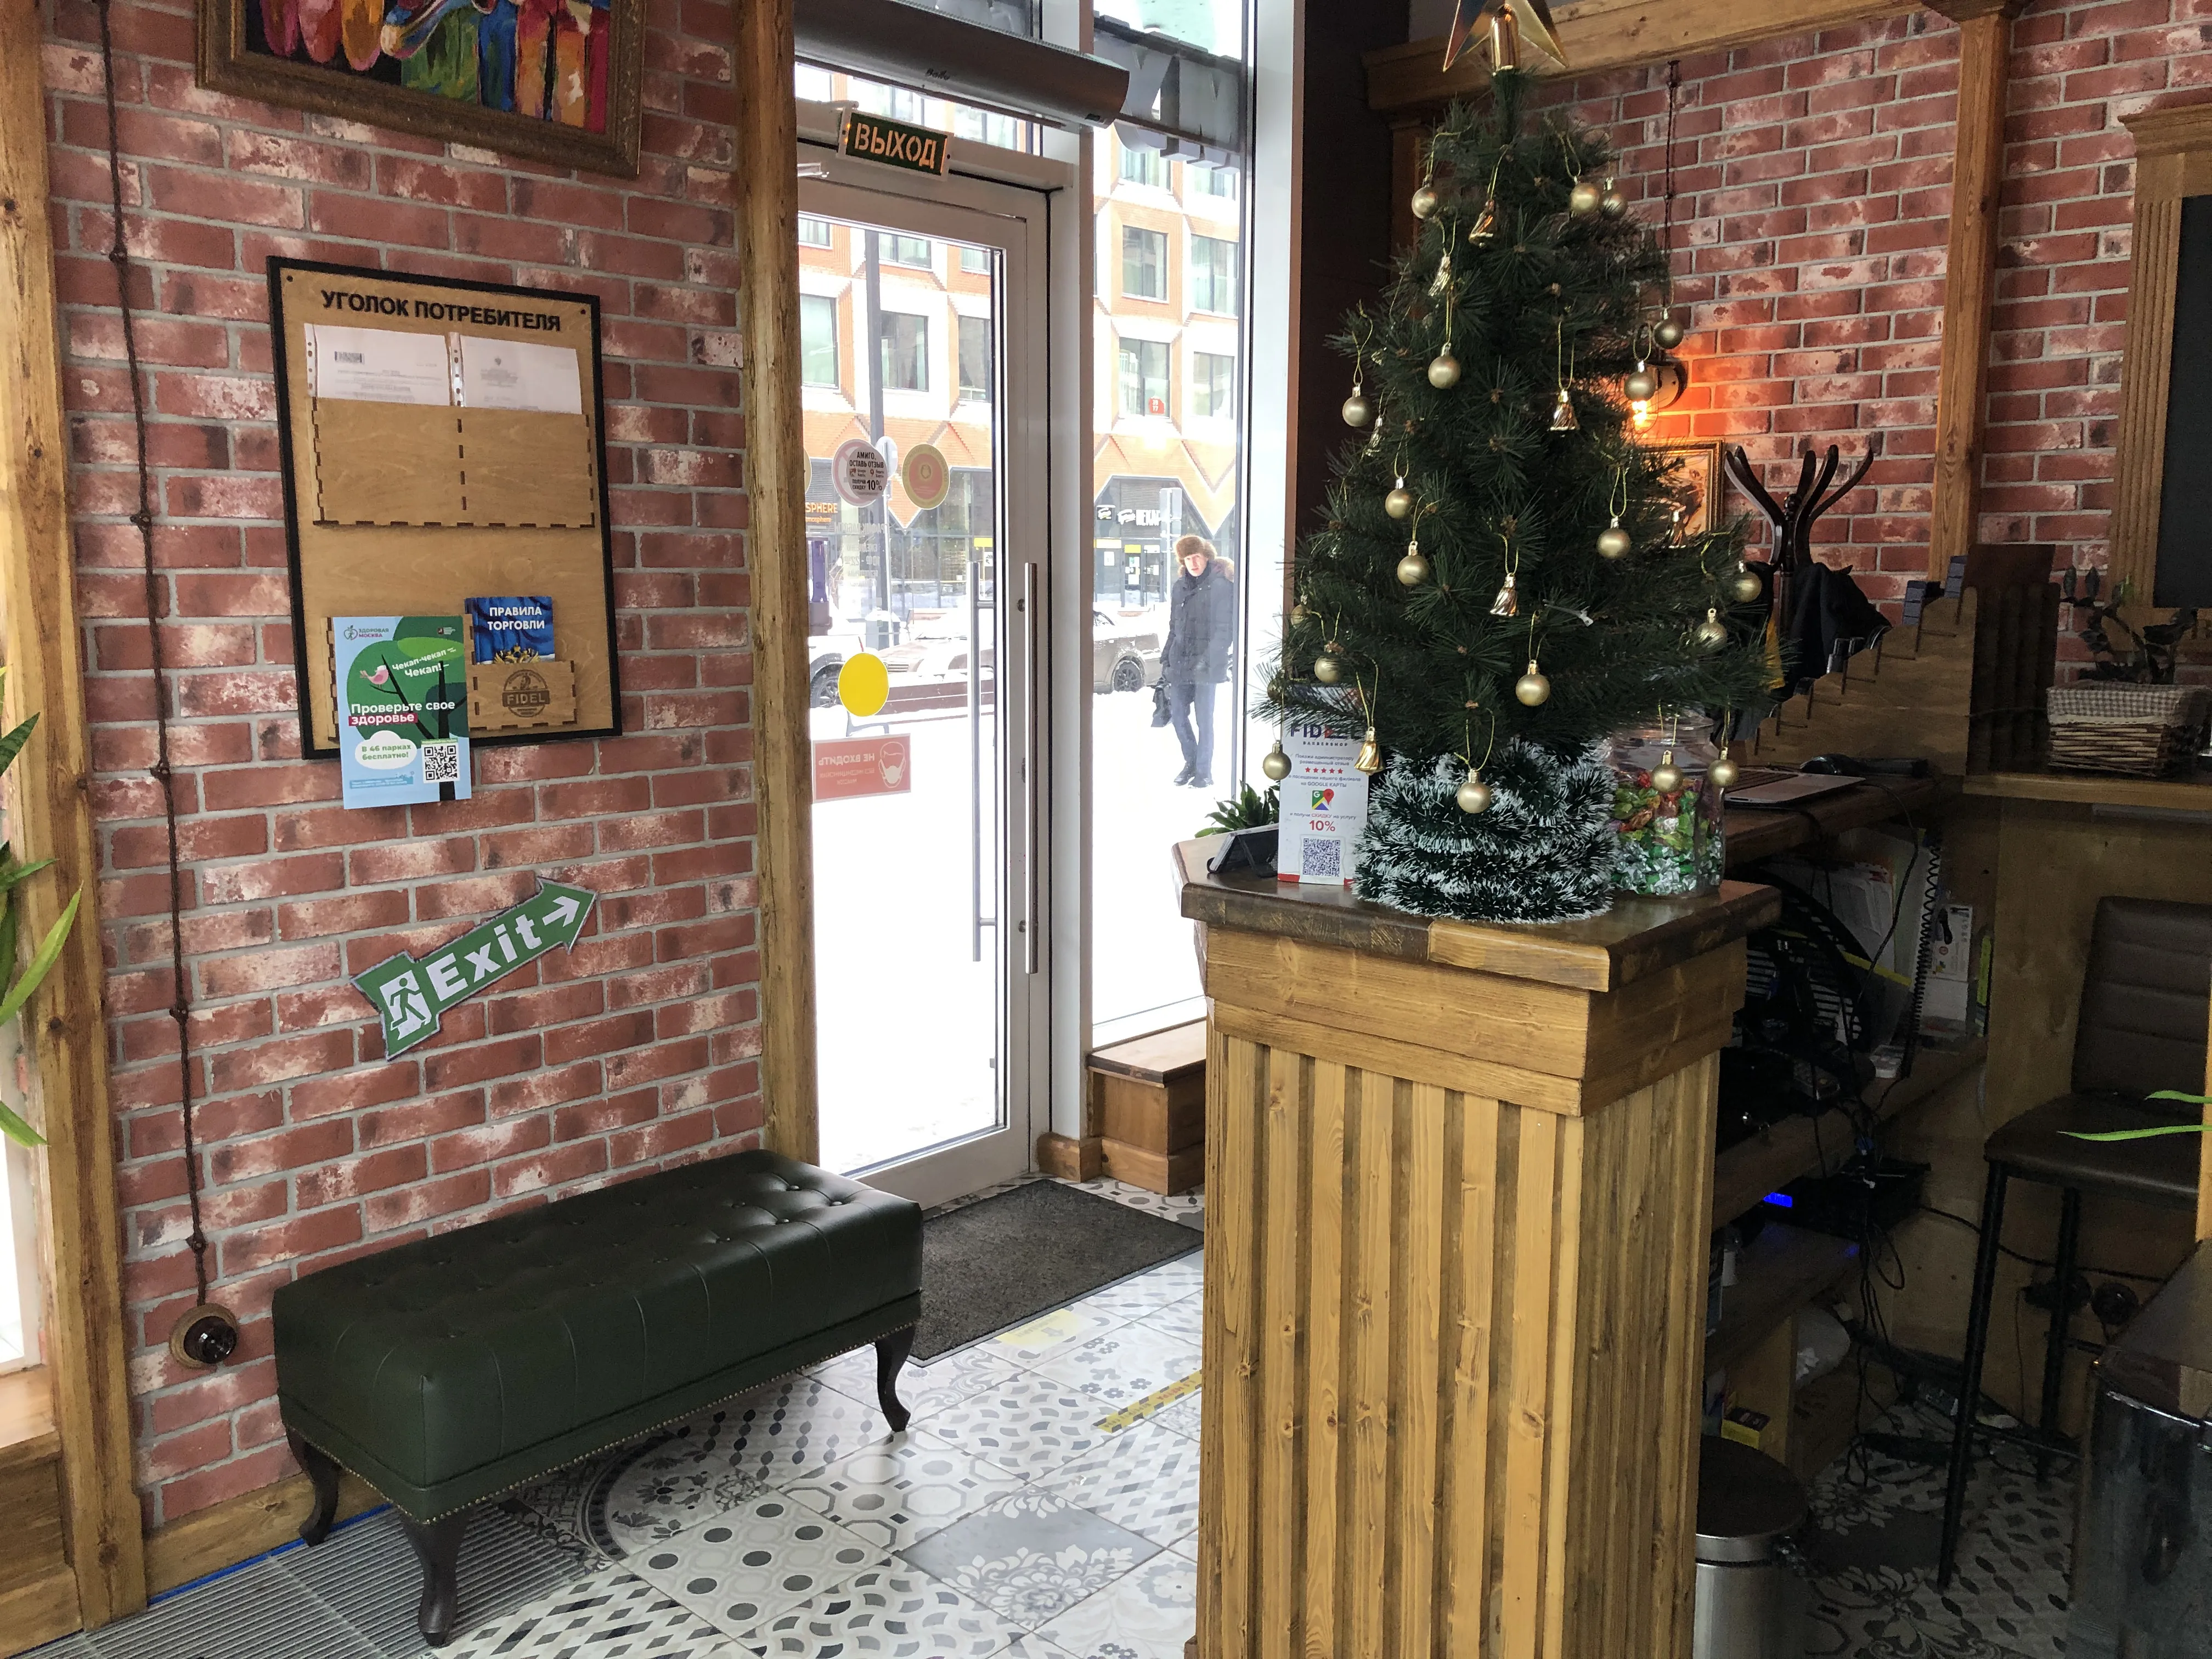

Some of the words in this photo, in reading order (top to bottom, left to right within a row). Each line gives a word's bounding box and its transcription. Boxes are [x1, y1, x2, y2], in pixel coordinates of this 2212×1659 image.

[854, 122, 936, 169] ВЫХОД
[321, 290, 409, 317] УГОЛОК
[414, 300, 561, 331] ПОТРЕБИТЕЛЯ
[857, 452, 876, 460] АМИГО,
[867, 479, 882, 490] 10%
[489, 606, 542, 617] ПРАВИЛА
[487, 620, 545, 630] ТОРГОВЛИ
[392, 649, 447, 670] Чекап-чекап
[404, 663, 442, 678] Чекап!
[507, 693, 545, 704] FIDEL
[351, 702, 422, 715] Проверьте
[426, 702, 455, 710] свое
[351, 714, 414, 725] здоровье
[362, 752, 409, 760] бесплатно!
[1309, 820, 1336, 832] 10%
[426, 914, 543, 1001] Exit
